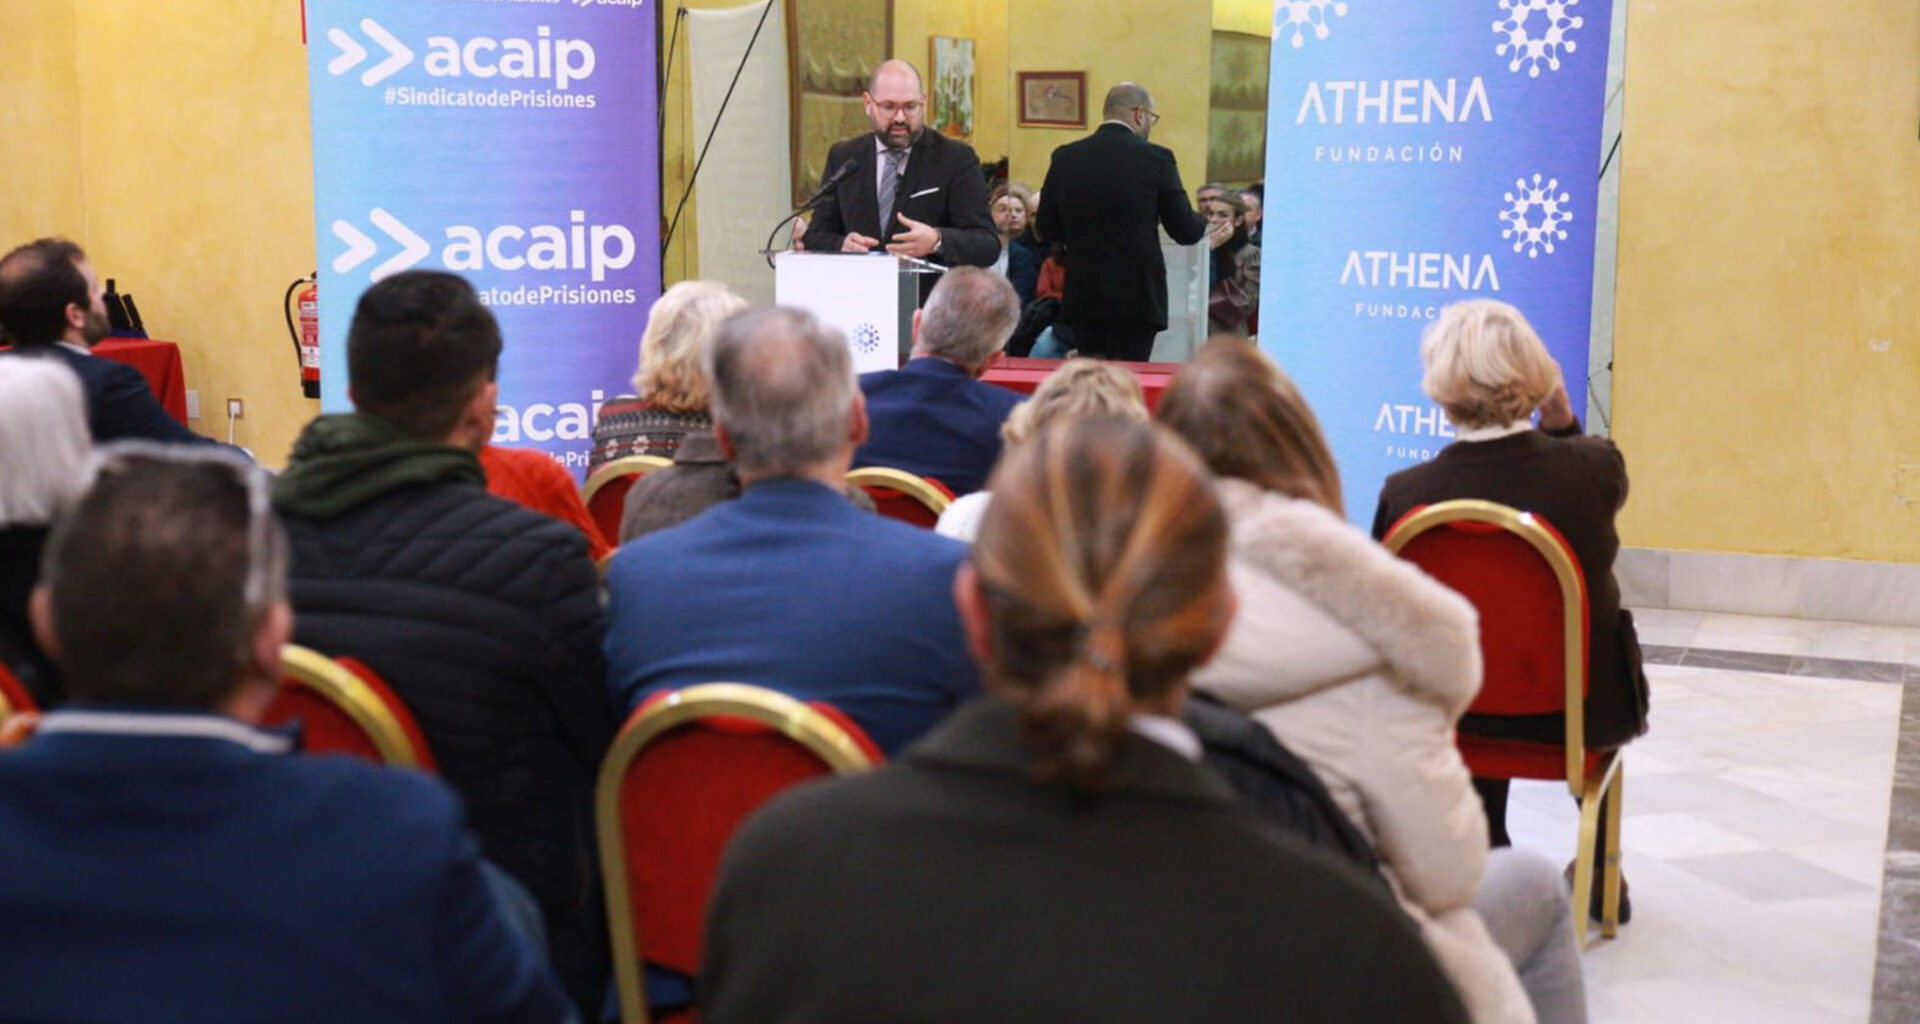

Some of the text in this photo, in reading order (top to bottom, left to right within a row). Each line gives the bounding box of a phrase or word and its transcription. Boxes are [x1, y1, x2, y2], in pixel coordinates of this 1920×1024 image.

[424, 26, 595, 89] acaip
[384, 87, 596, 109] #SindicatodePrisiones
[1296, 76, 1493, 124] ATHENA
[1315, 142, 1463, 162] FUNDACIÓN
[442, 210, 636, 281] acaip
[1340, 250, 1500, 291] ATHENA
[479, 284, 636, 306] atodePrisiones
[1355, 303, 1436, 319] FUNDAC
[491, 390, 637, 442] acai
[1374, 402, 1457, 438] ATHE
